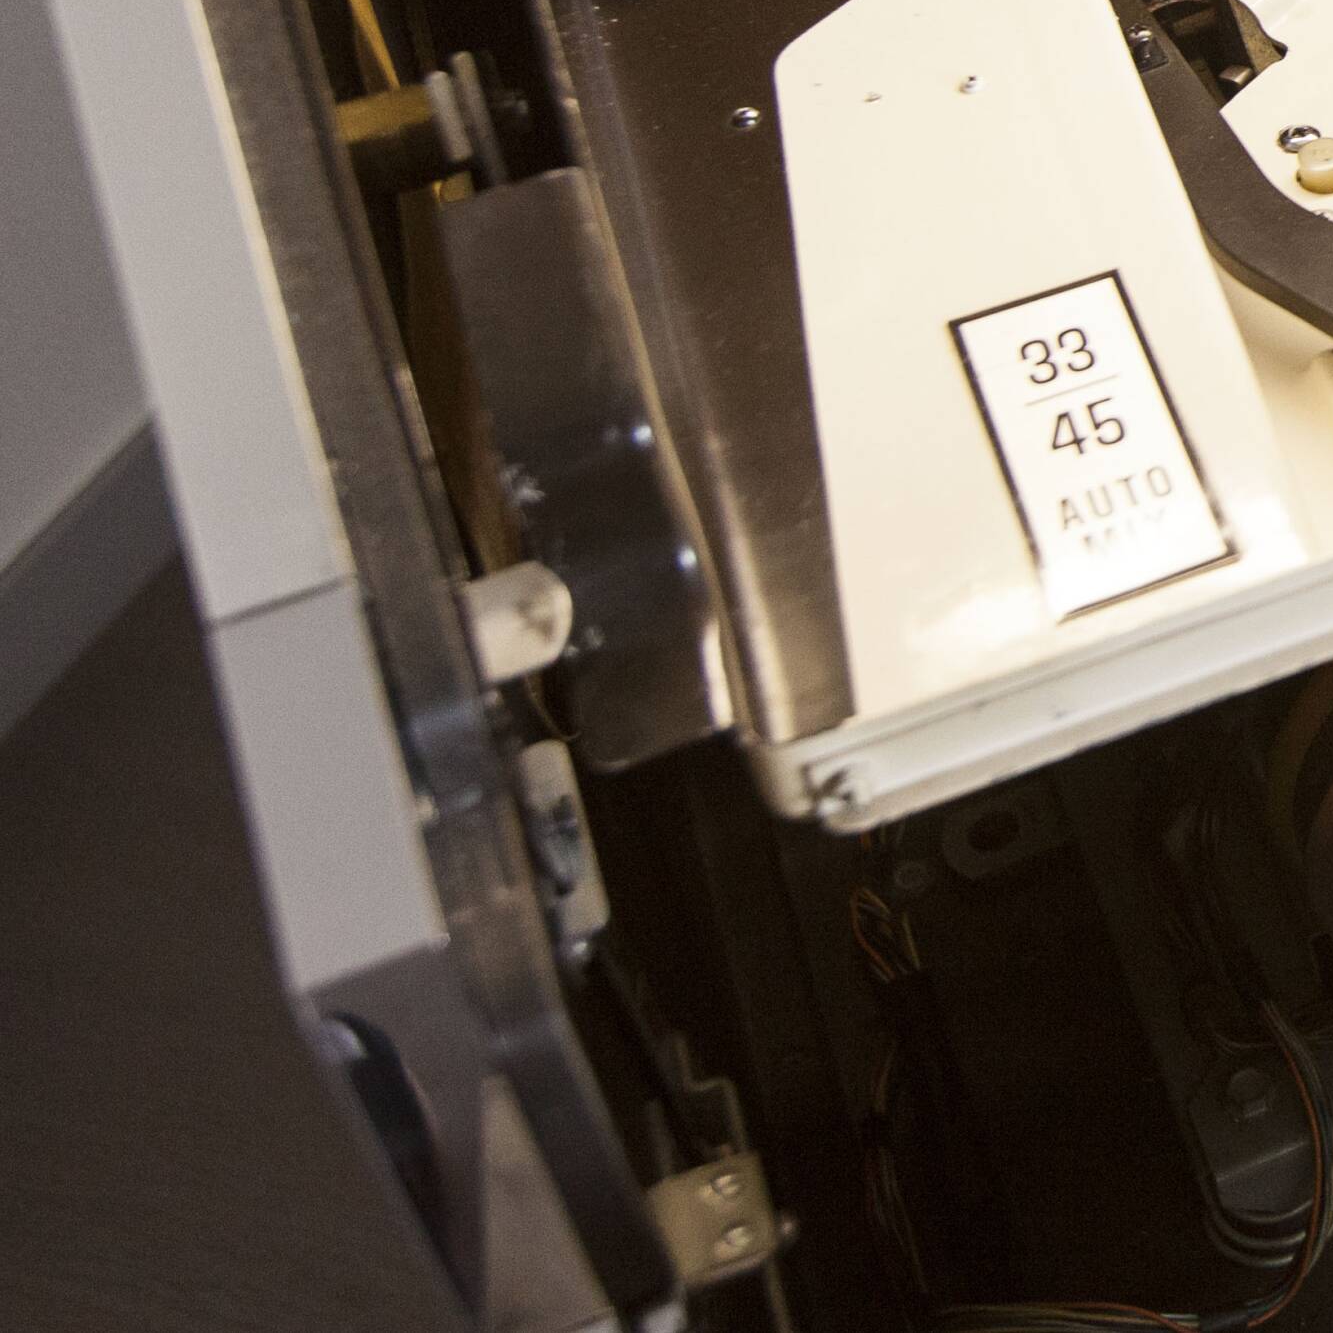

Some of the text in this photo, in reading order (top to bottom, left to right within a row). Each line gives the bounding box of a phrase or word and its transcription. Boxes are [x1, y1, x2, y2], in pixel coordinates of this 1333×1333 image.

[1019, 327, 1095, 385] 33
[1051, 397, 1126, 455] 45
[1058, 464, 1174, 532] AUTO
